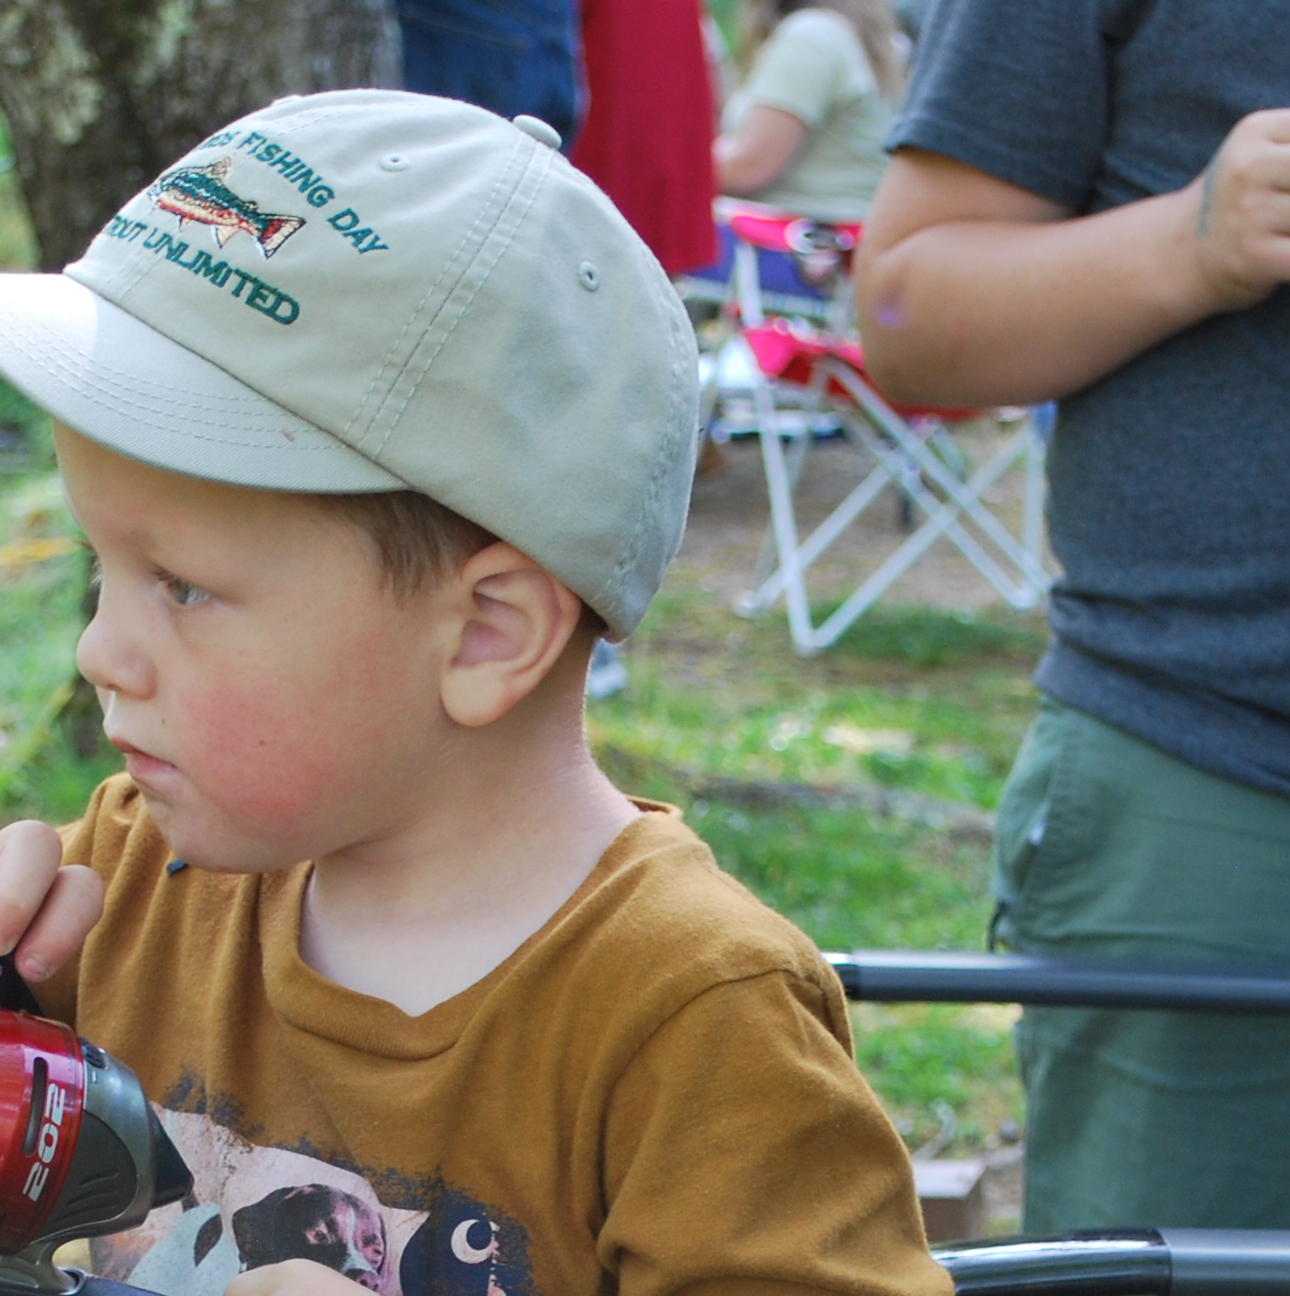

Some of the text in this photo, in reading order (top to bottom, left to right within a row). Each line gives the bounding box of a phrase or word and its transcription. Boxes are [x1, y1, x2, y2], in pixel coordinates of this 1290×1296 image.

[238, 131, 336, 208] FISHING
[327, 206, 389, 255] DAY
[144, 227, 300, 325] UNLIMITED
[22, 1083, 65, 1202] 202
